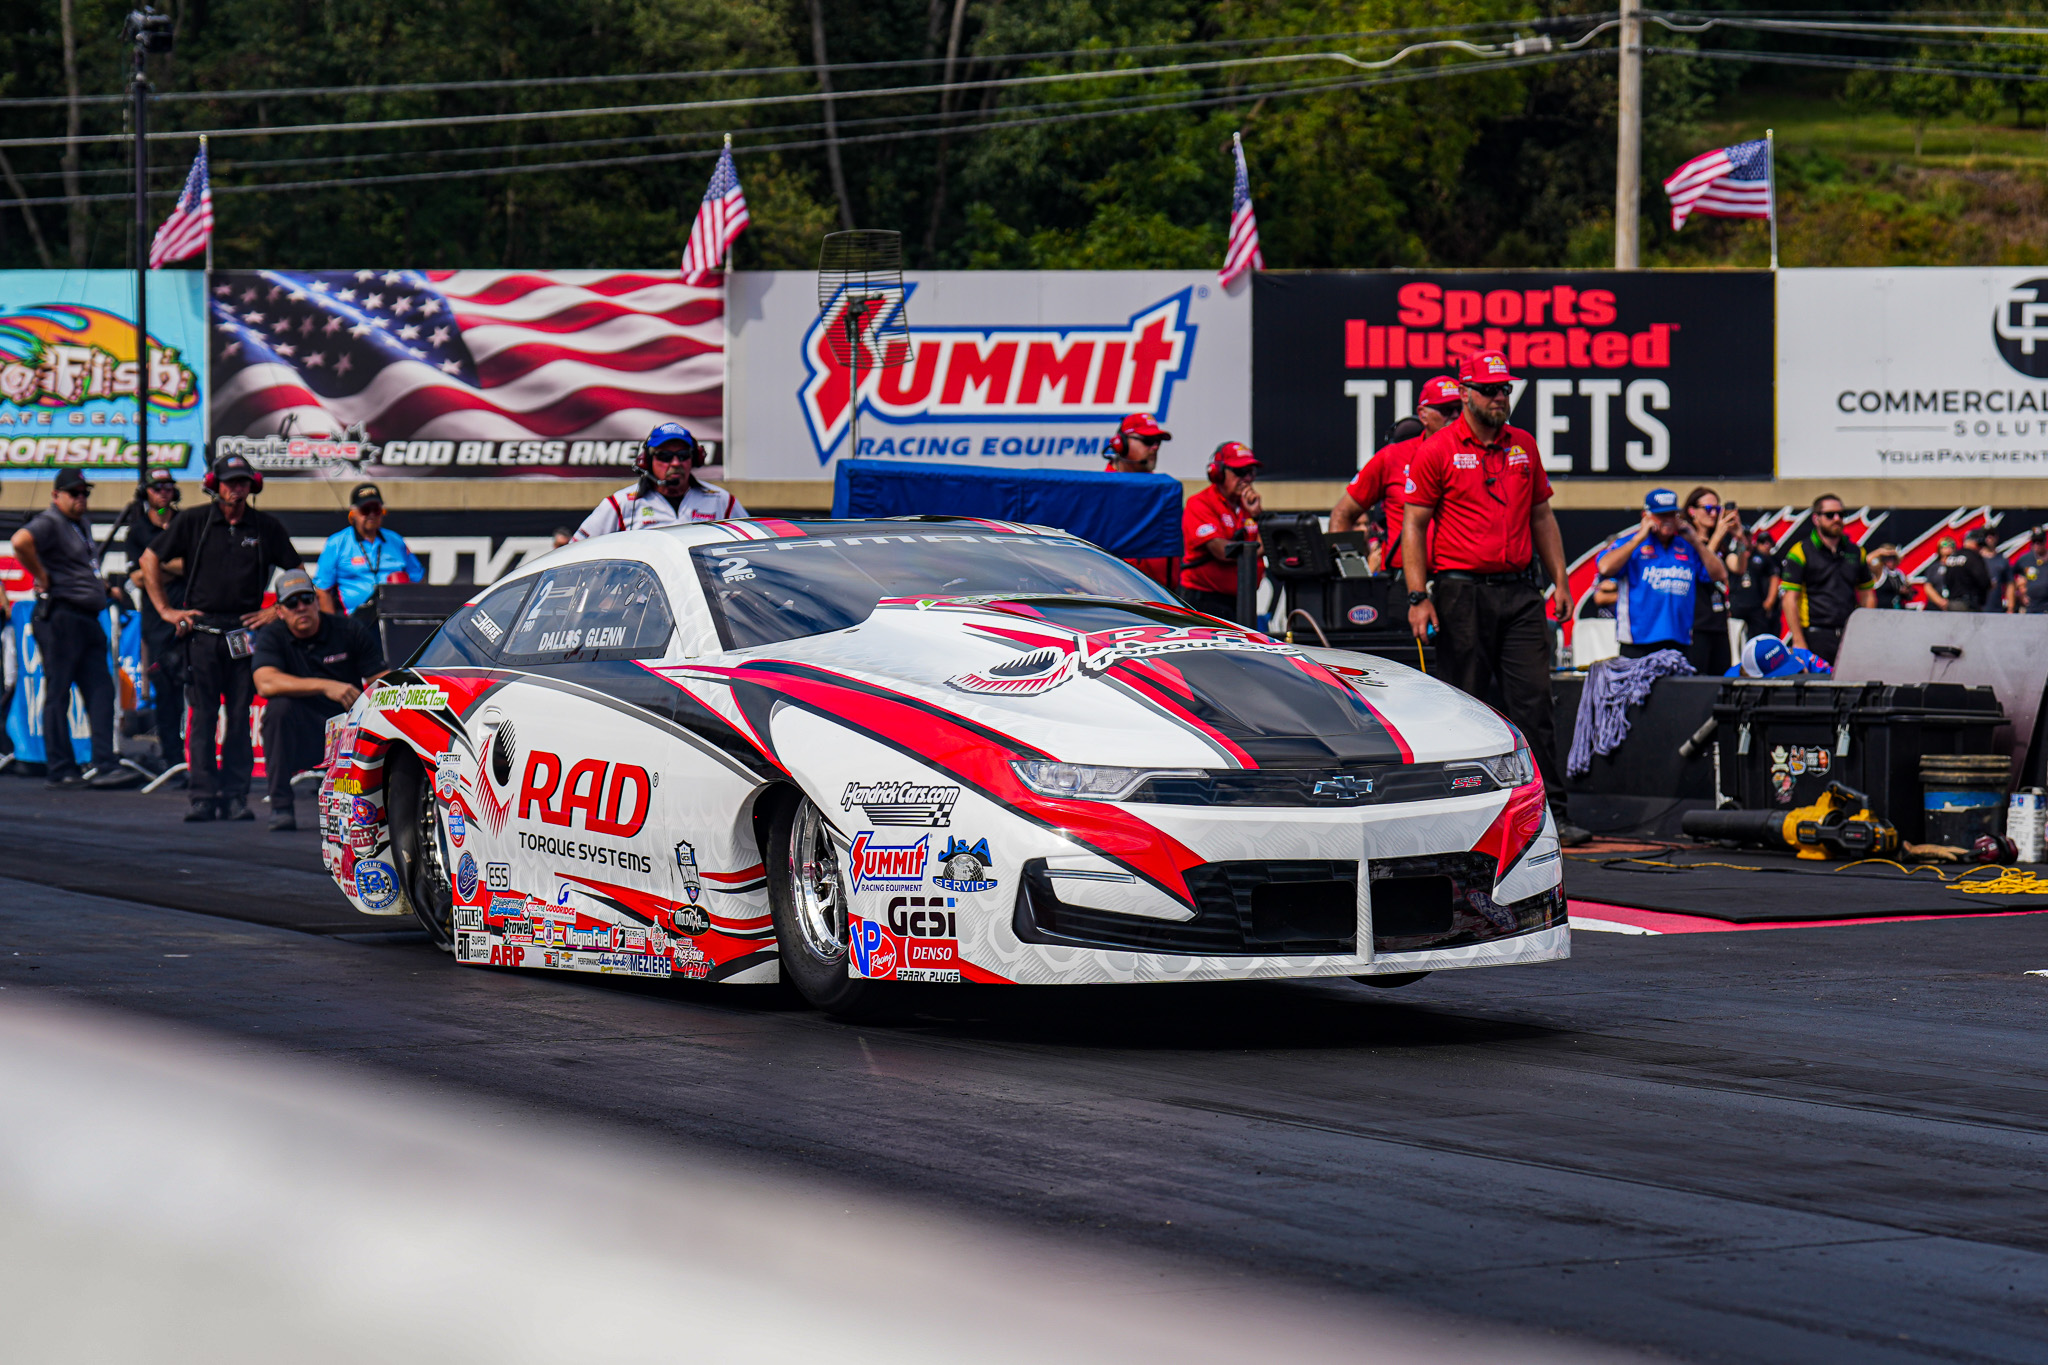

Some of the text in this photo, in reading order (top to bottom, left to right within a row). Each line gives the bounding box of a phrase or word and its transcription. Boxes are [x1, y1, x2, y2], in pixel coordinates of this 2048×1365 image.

[1397, 282, 1618, 330] Sports
[1344, 319, 1671, 368] Illustrated
[1344, 378, 1671, 472] TETS
[381, 440, 454, 465] GOD
[456, 440, 566, 465] BLESS
[857, 437, 1114, 457] RACING EQUIPM
[710, 534, 1085, 556] CAMARO
[718, 557, 754, 579] 2
[724, 572, 757, 584] PRO
[527, 580, 555, 619] 2
[521, 619, 536, 632] PRO
[584, 627, 628, 648] GLENN
[1451, 775, 1483, 790] SS
[518, 750, 652, 838] RAD
[841, 782, 961, 810] HendrickCars.com
[518, 832, 576, 858] TORQUE
[578, 843, 652, 874] SYSTEMS
[938, 835, 993, 866] J&A
[488, 867, 509, 888] ESS
[934, 877, 996, 892] SERVICE
[861, 884, 923, 893] RACING EQUIPMENT
[453, 905, 485, 930] ROTTLER
[545, 904, 576, 916] GOODRIDGE
[503, 918, 534, 935] Browell
[471, 936, 487, 946] SUPER
[566, 924, 611, 951] MagnaFuel
[470, 948, 489, 959] DAMPER
[491, 945, 525, 967] ARP
[850, 919, 883, 978] VP
[912, 946, 952, 961] DENSO
[630, 954, 671, 974] MEZIERE
[685, 961, 709, 979] PRO
[870, 952, 896, 971] Racing
[896, 969, 959, 983] SPARK PLUGS
